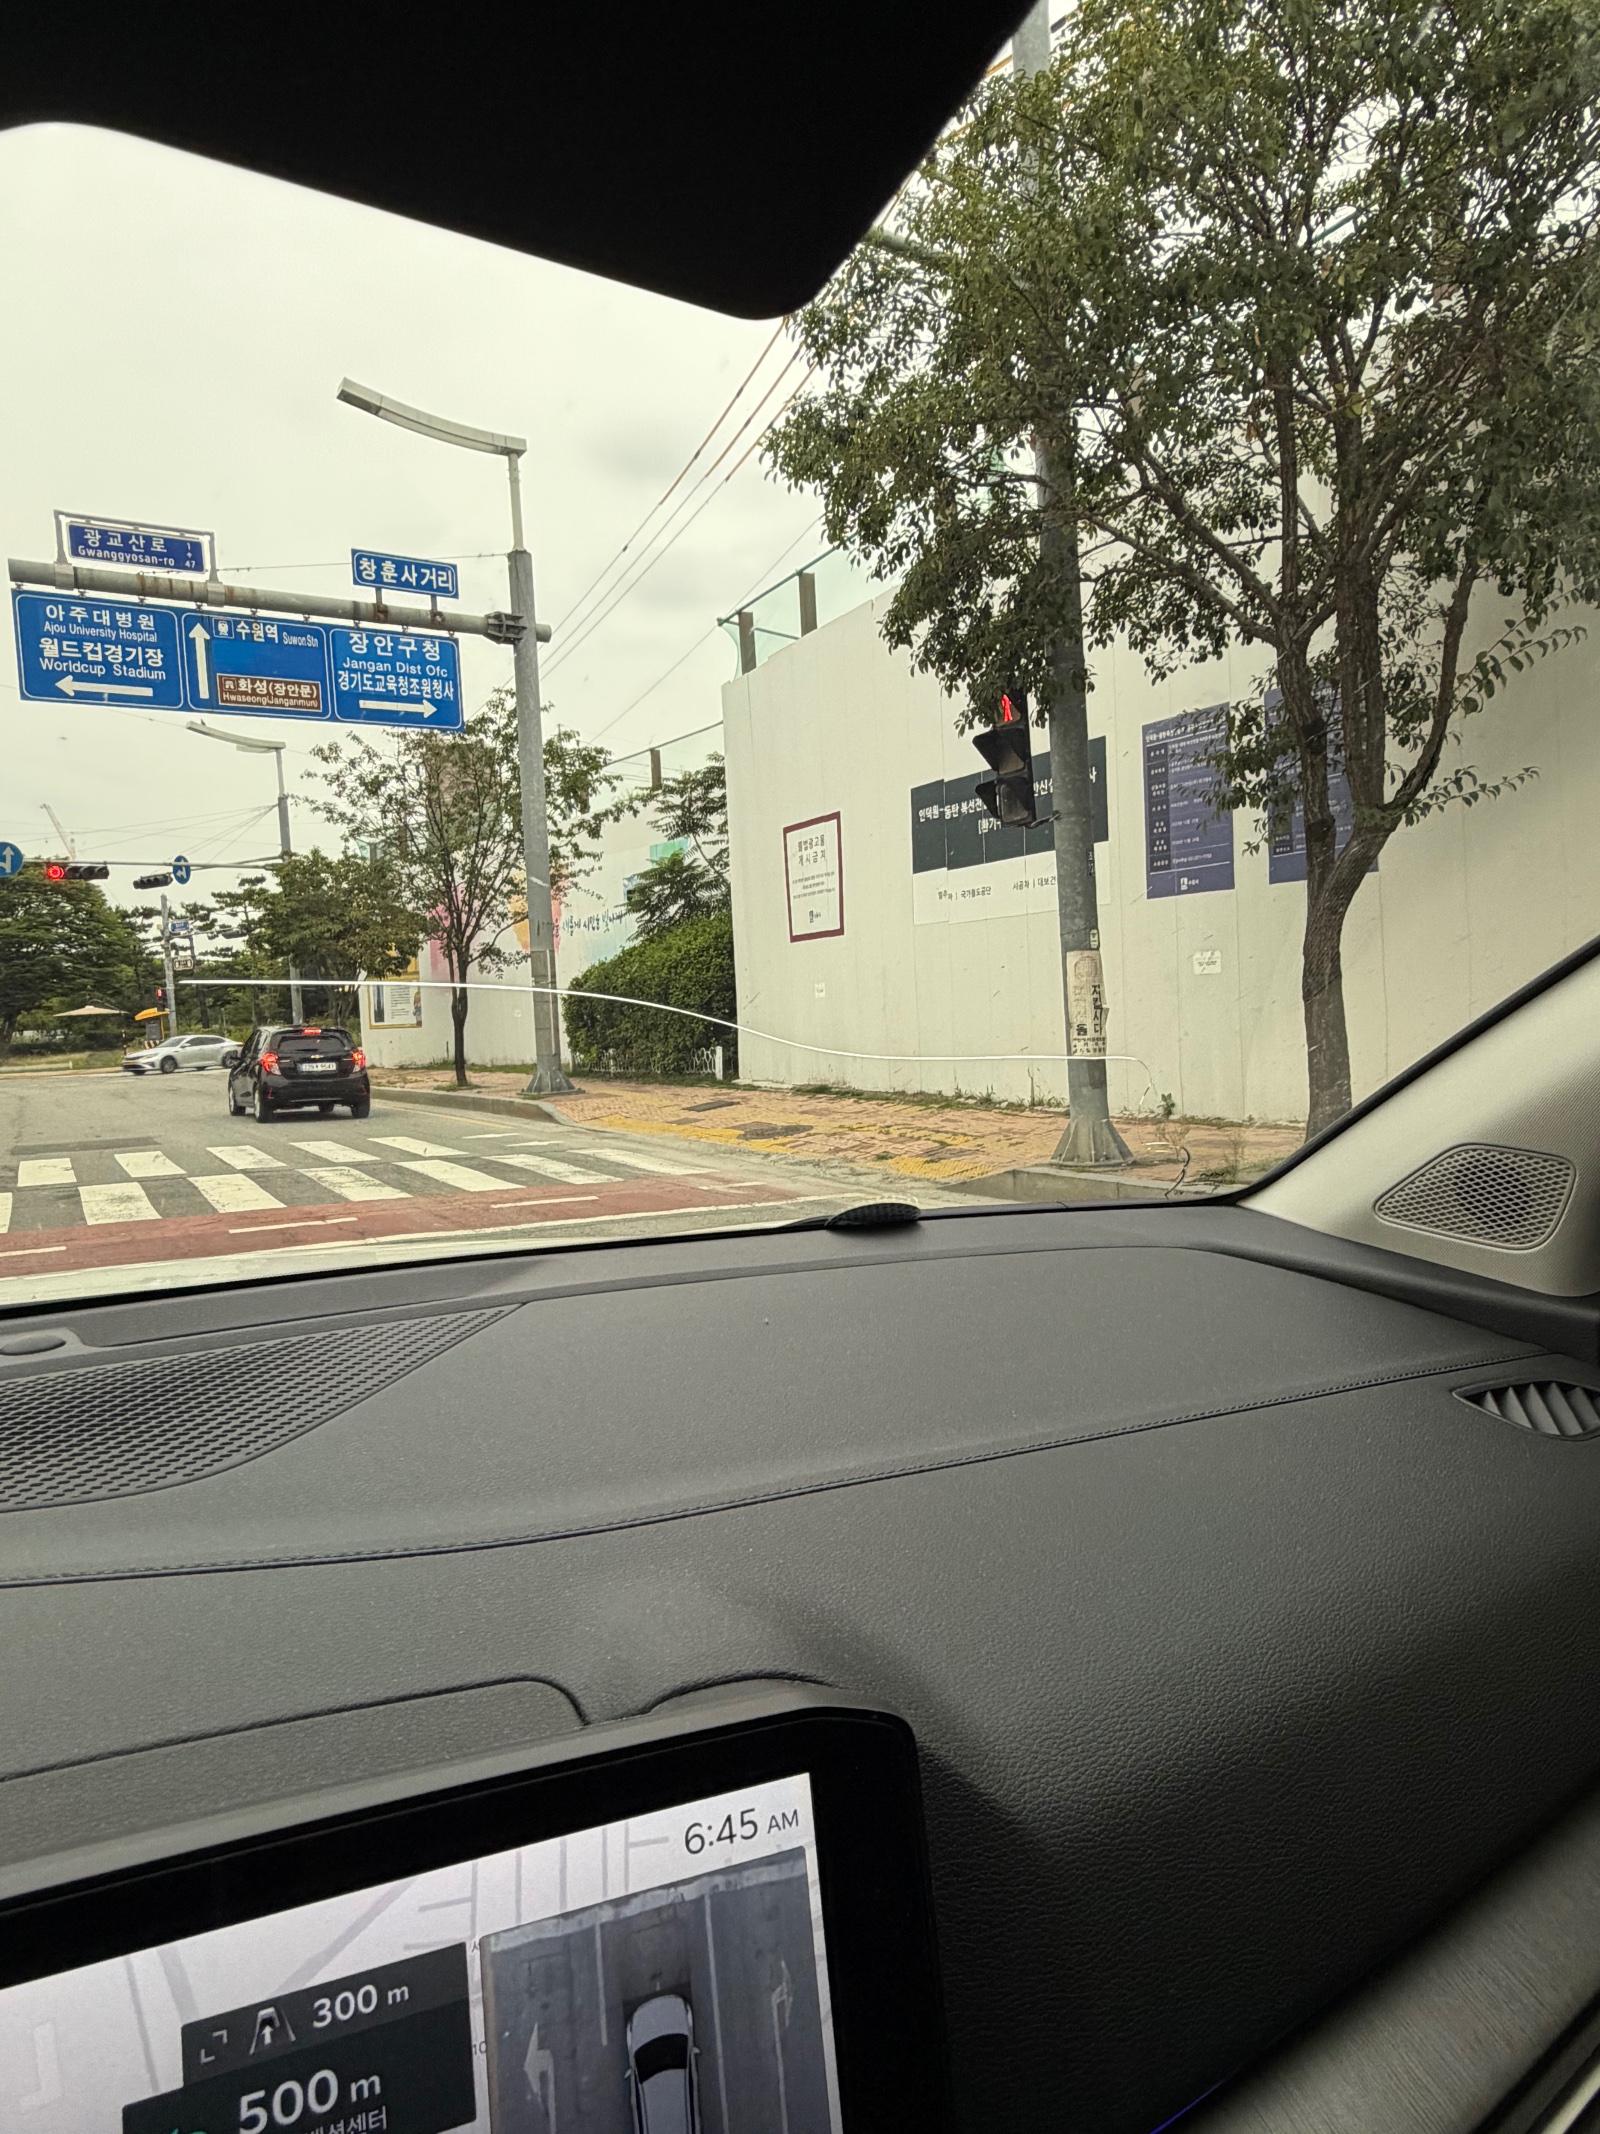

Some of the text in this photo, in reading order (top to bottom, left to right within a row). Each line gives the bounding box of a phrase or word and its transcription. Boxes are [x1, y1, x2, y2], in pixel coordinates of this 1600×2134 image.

[83, 528, 167, 553] 광교산로
[78, 545, 175, 566] Gwanggyosan-ro
[184, 560, 196, 569] 47
[359, 557, 453, 592] 창훈사거리
[45, 604, 155, 631] 아주대병원
[44, 621, 158, 643] Ajou University Hospital
[236, 620, 279, 644] 수원역
[282, 631, 319, 648] Suwon Stn
[39, 637, 164, 667] 월드컵경기장
[349, 632, 441, 662] 장안구청
[39, 657, 166, 681] Worldcup Stadium
[343, 657, 448, 678] Jangan Dist Ofc
[238, 678, 317, 699] 화성(장안문)
[338, 670, 454, 701] 경기도교육청조원청사
[960, 797, 988, 815] 복선전
[1037, 875, 1056, 887] 대보건
[685, 1807, 799, 1855] 6:45 AM
[312, 1984, 410, 2029] 300 m
[239, 2068, 382, 2134] 500 m
